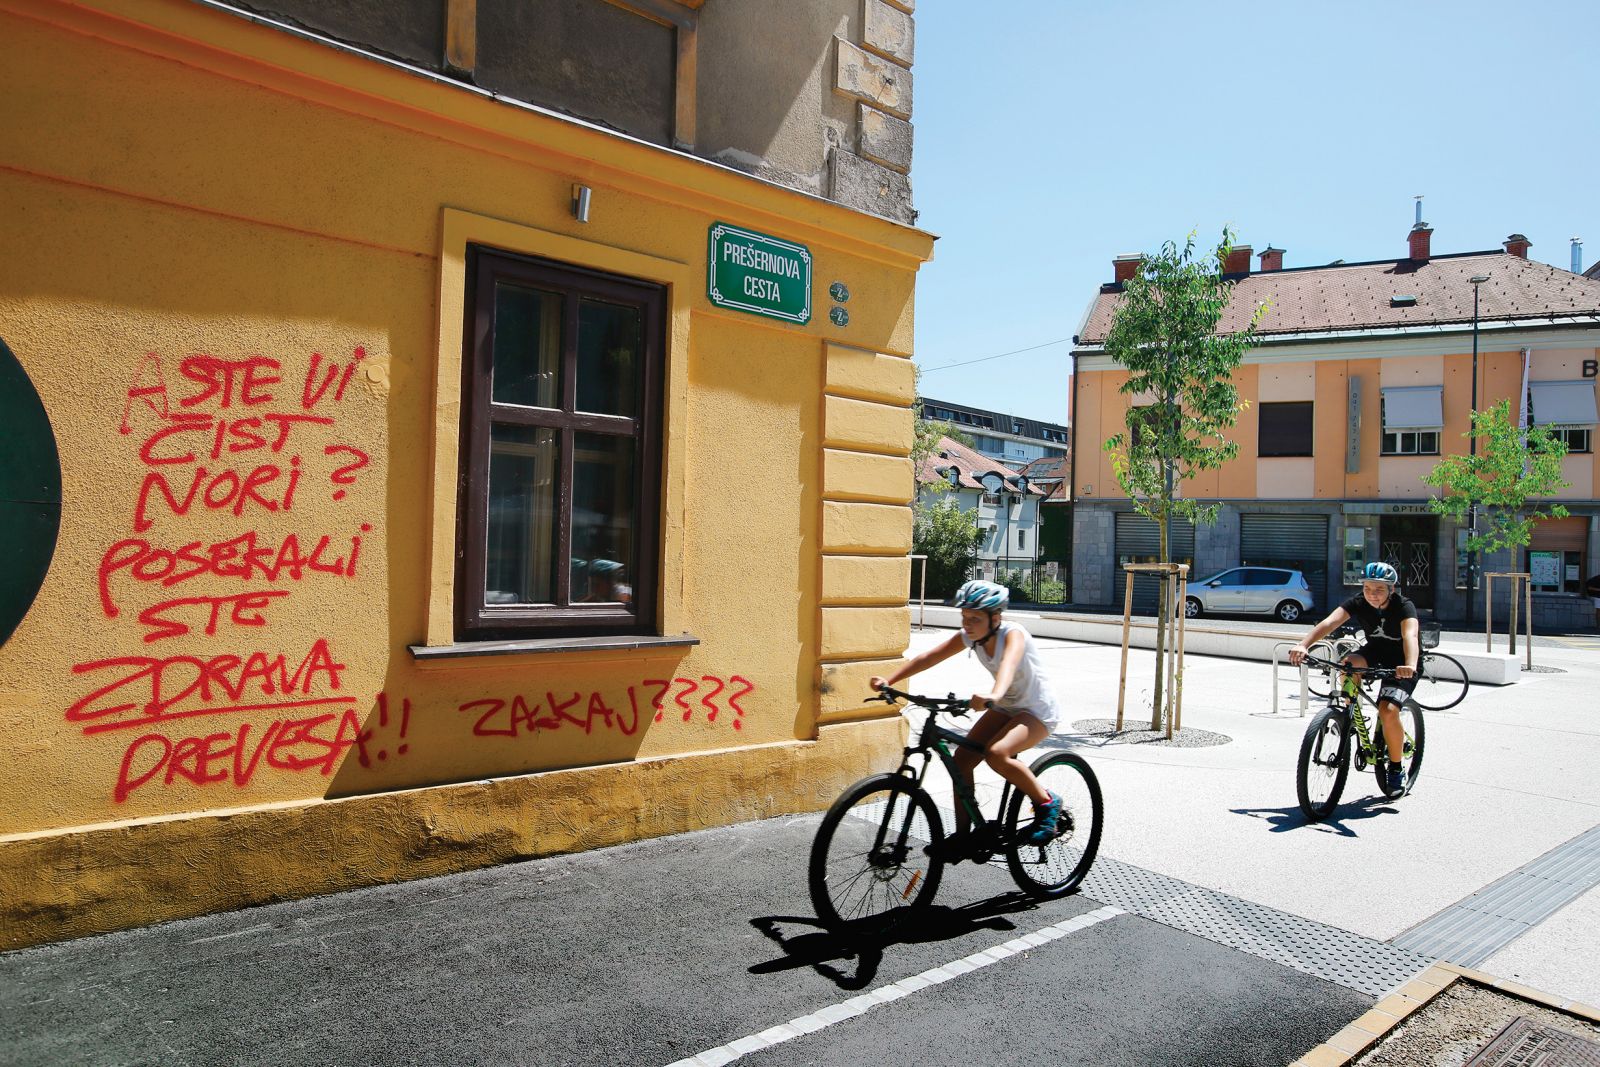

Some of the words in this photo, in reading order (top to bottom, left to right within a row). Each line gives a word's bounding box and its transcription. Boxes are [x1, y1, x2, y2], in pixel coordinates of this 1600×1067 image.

[723, 241, 800, 280] PREŠERNOVA
[743, 275, 781, 303] CESTA
[179, 354, 281, 408] STE
[1582, 359, 1599, 378] B
[138, 590, 289, 643] STE
[65, 639, 346, 722] ZDRAVA
